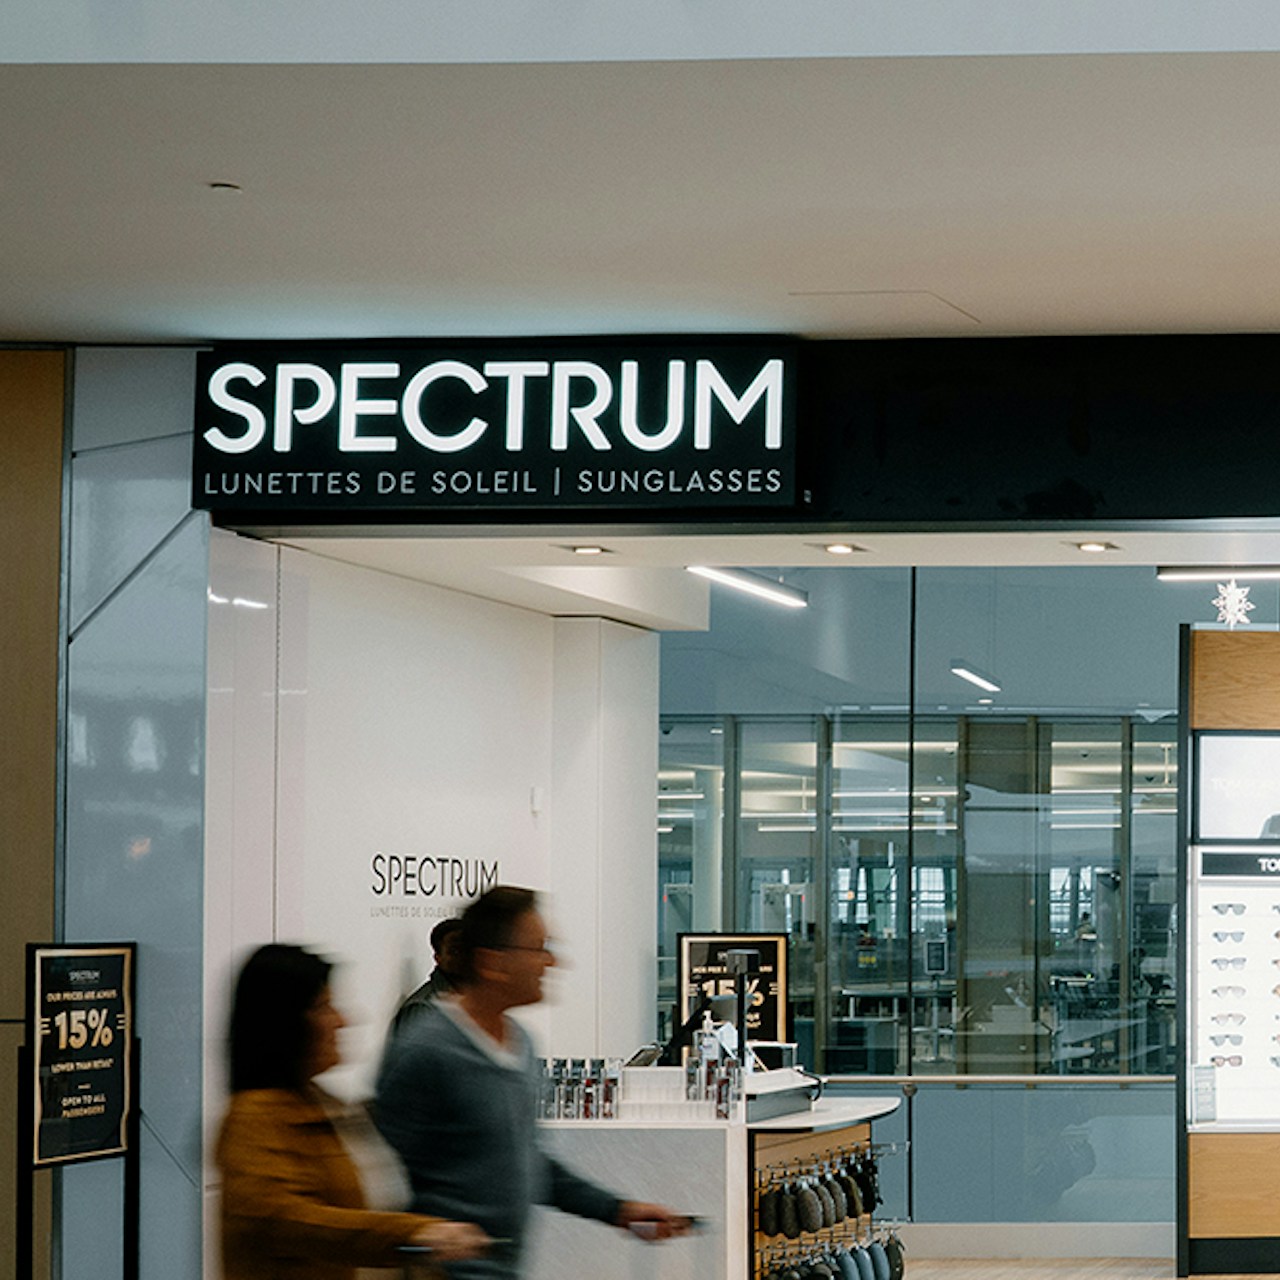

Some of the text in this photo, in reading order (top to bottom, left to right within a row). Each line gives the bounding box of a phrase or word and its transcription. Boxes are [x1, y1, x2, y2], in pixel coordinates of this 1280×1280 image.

[204, 360, 784, 453] SPECTRUM
[204, 472, 361, 494] LUNETTES
[377, 472, 416, 494] DE
[431, 471, 537, 494] SOLEIL
[577, 468, 782, 493] SUNGLASSES
[372, 854, 498, 898] SPECTRUM
[55, 1008, 113, 1049] 15%
